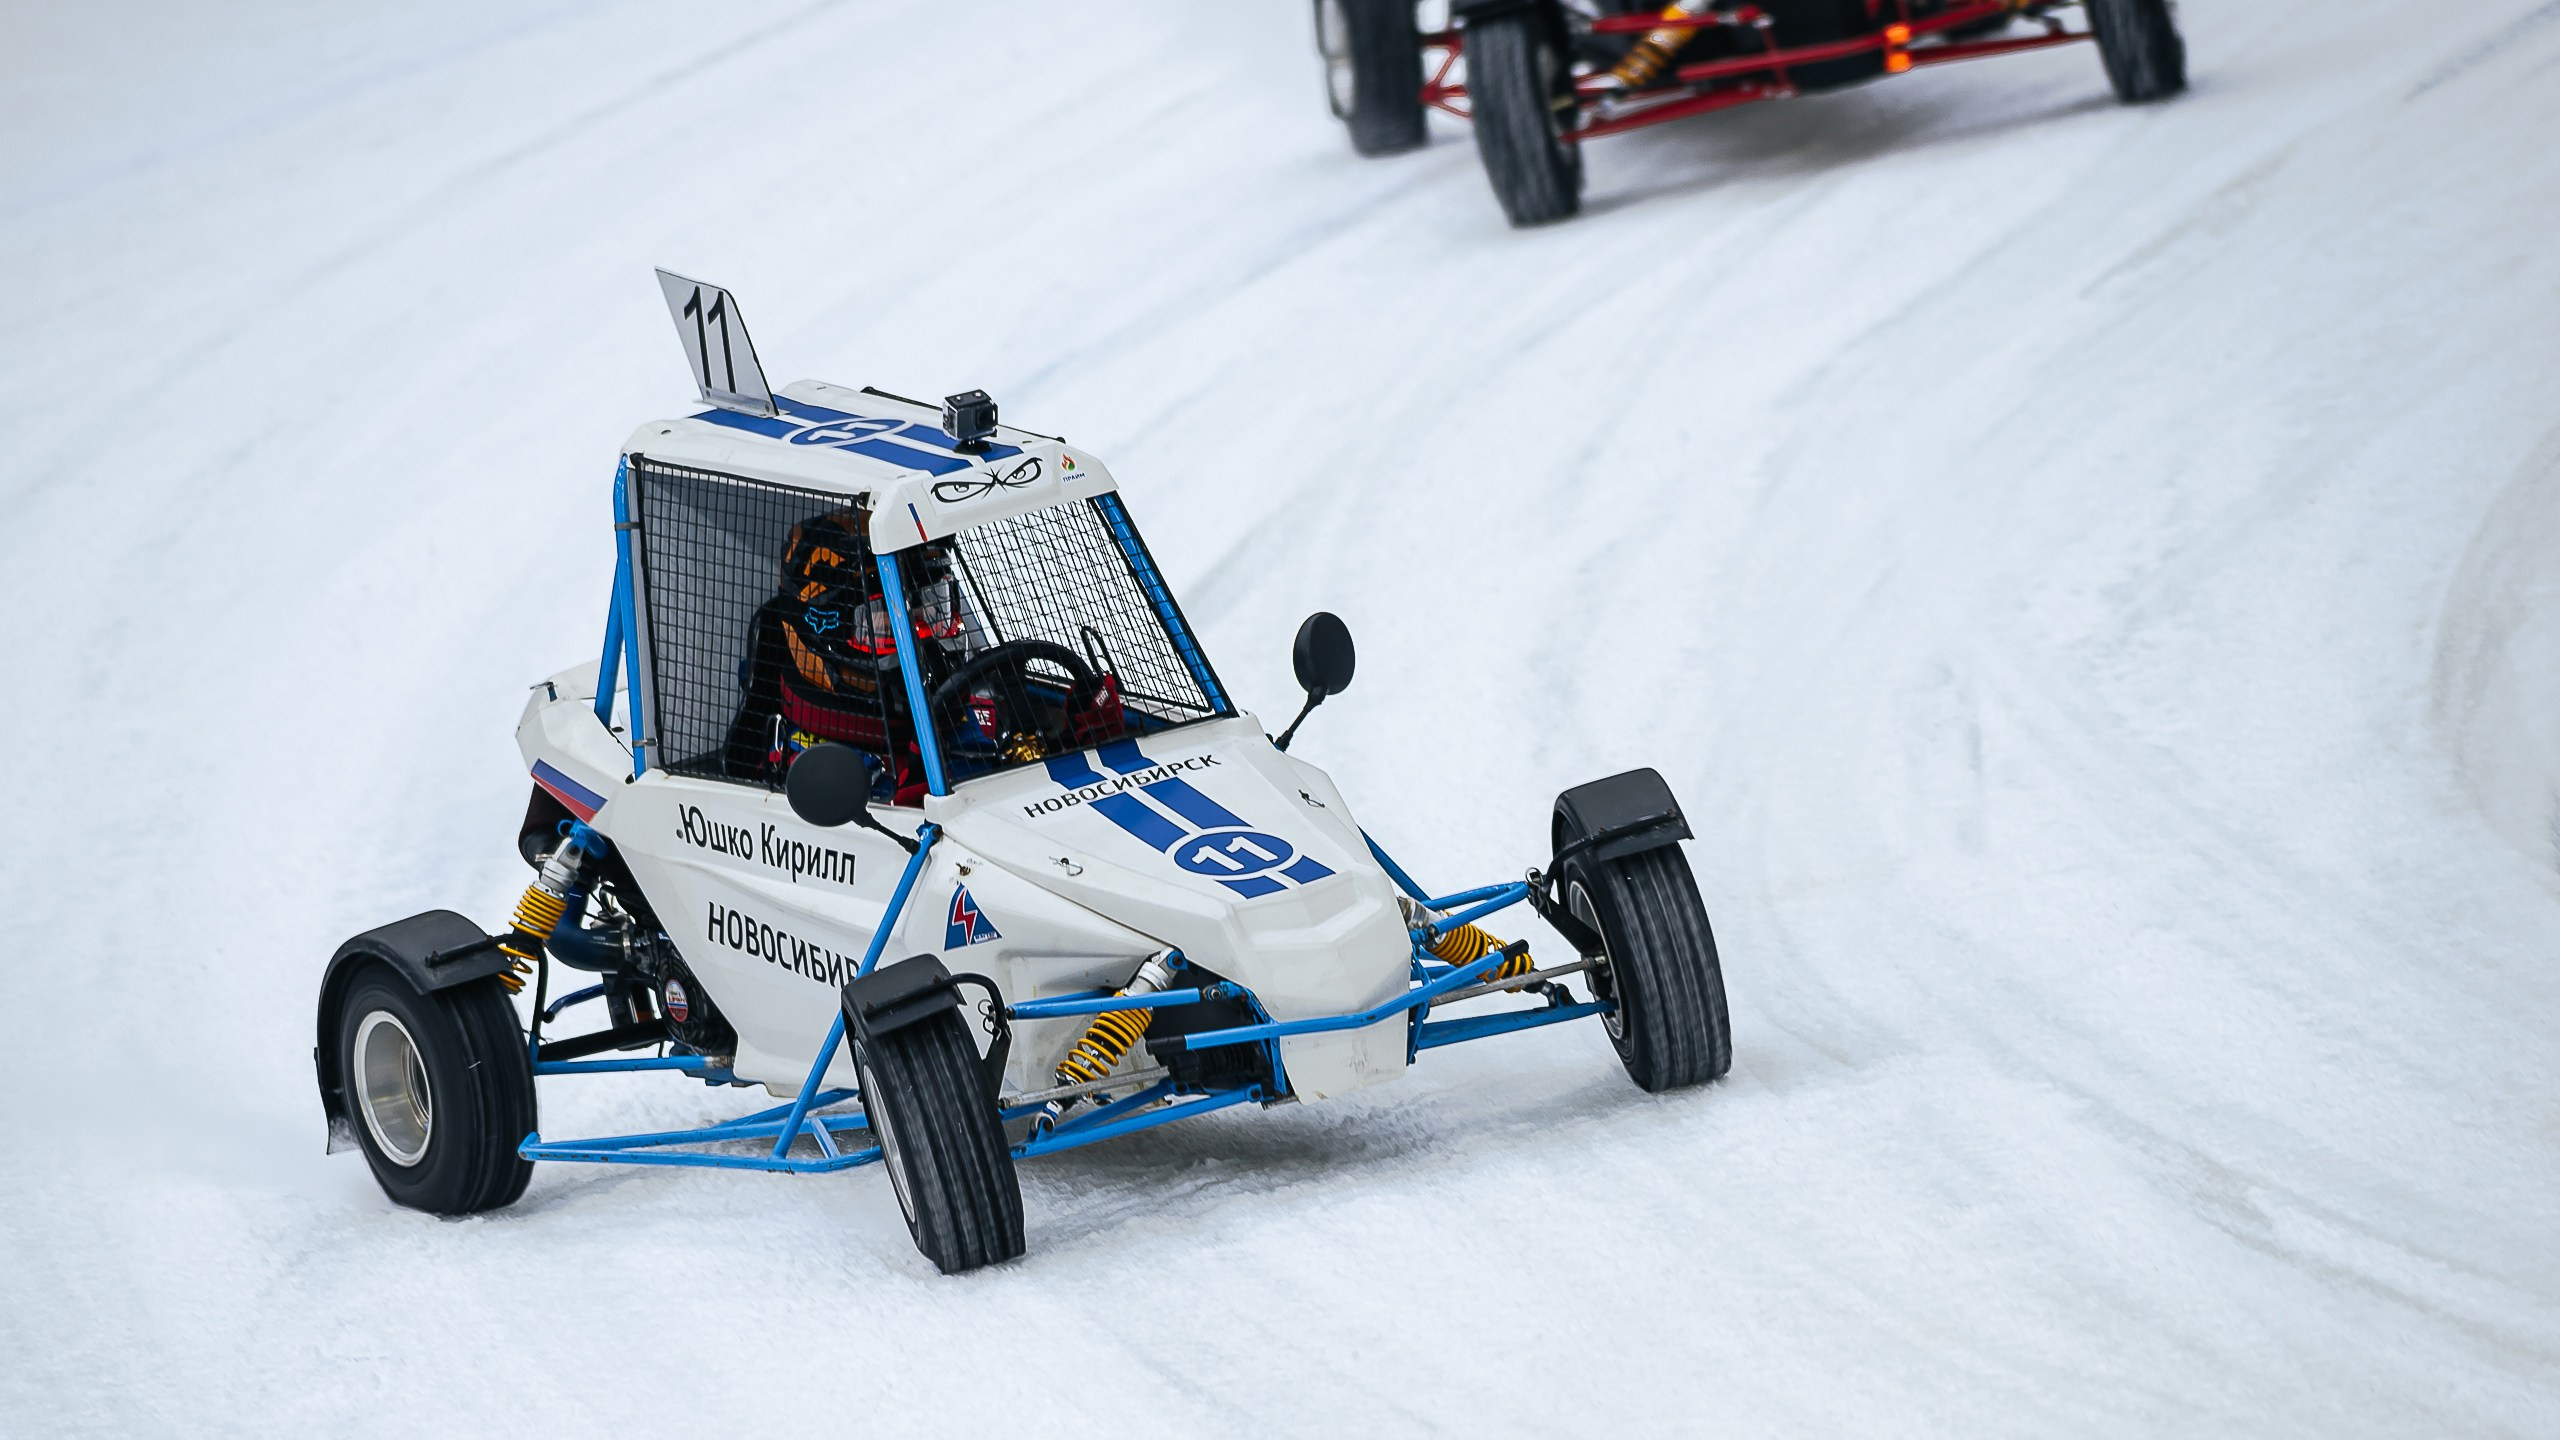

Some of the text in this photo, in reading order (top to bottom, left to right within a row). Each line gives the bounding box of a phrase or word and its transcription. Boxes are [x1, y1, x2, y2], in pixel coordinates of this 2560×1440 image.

[683, 285, 737, 395] 11
[807, 421, 889, 441] 11
[1062, 472, 1086, 483] ПРАЙМ
[1023, 754, 1222, 819] НОВОСИБИРСК
[678, 803, 856, 886] Юшко Кирилл
[1191, 835, 1278, 872] 11
[708, 901, 862, 990] НОВОСИБИР
